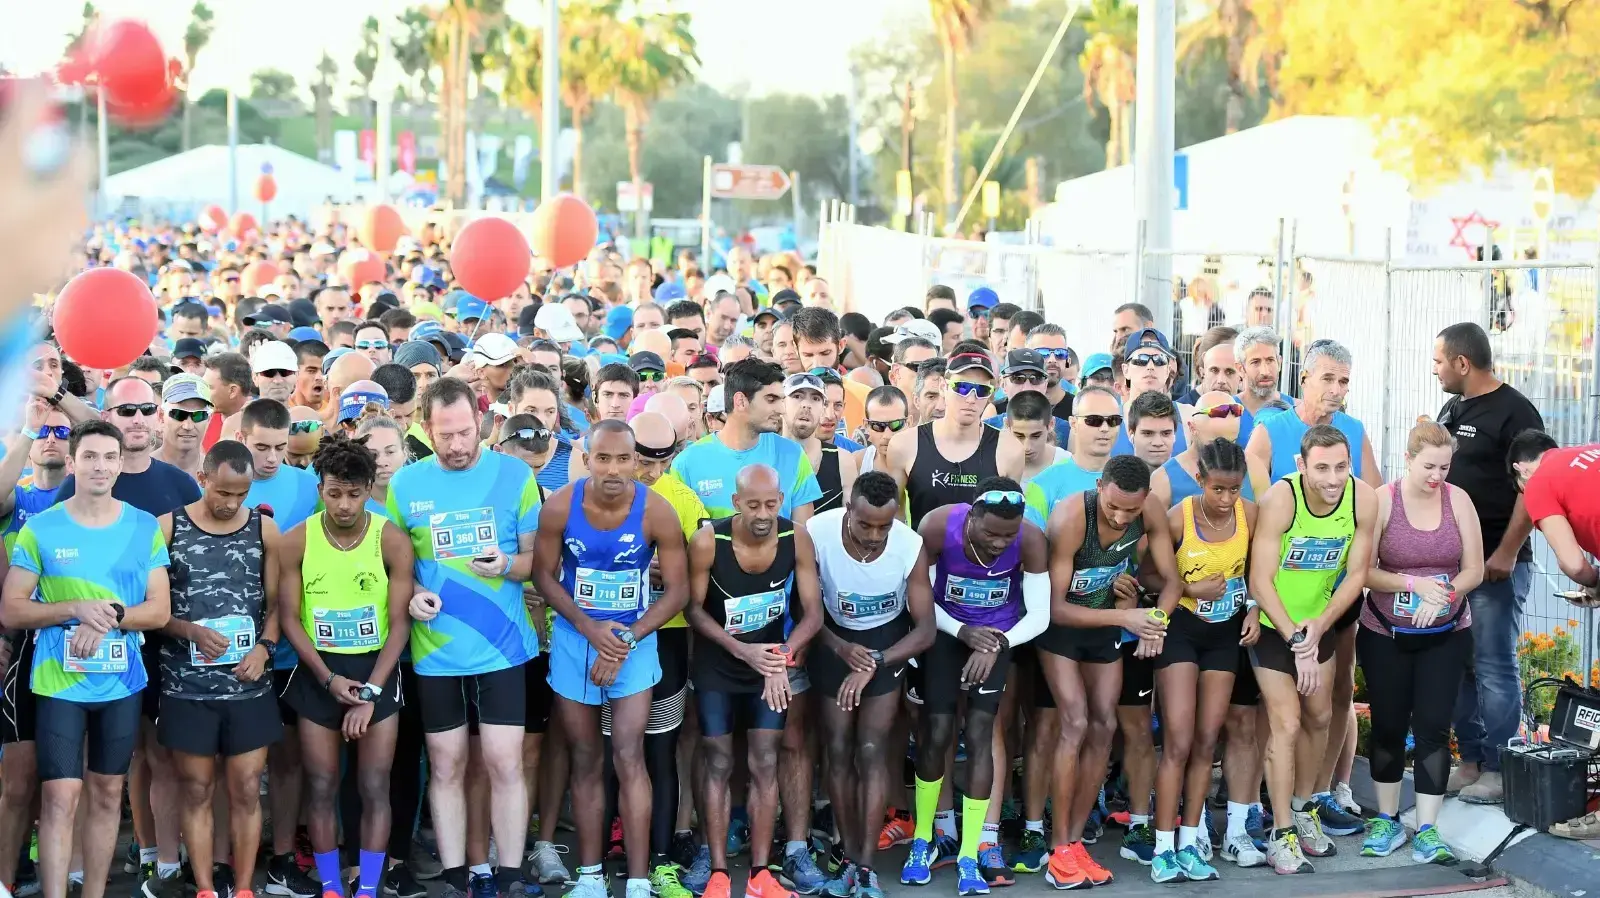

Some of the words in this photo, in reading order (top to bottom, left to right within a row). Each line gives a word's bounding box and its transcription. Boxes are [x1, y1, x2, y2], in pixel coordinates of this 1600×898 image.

[456, 532, 474, 545] 360
[598, 589, 616, 600] 716
[1216, 600, 1231, 612] 717
[337, 628, 356, 637] 715
